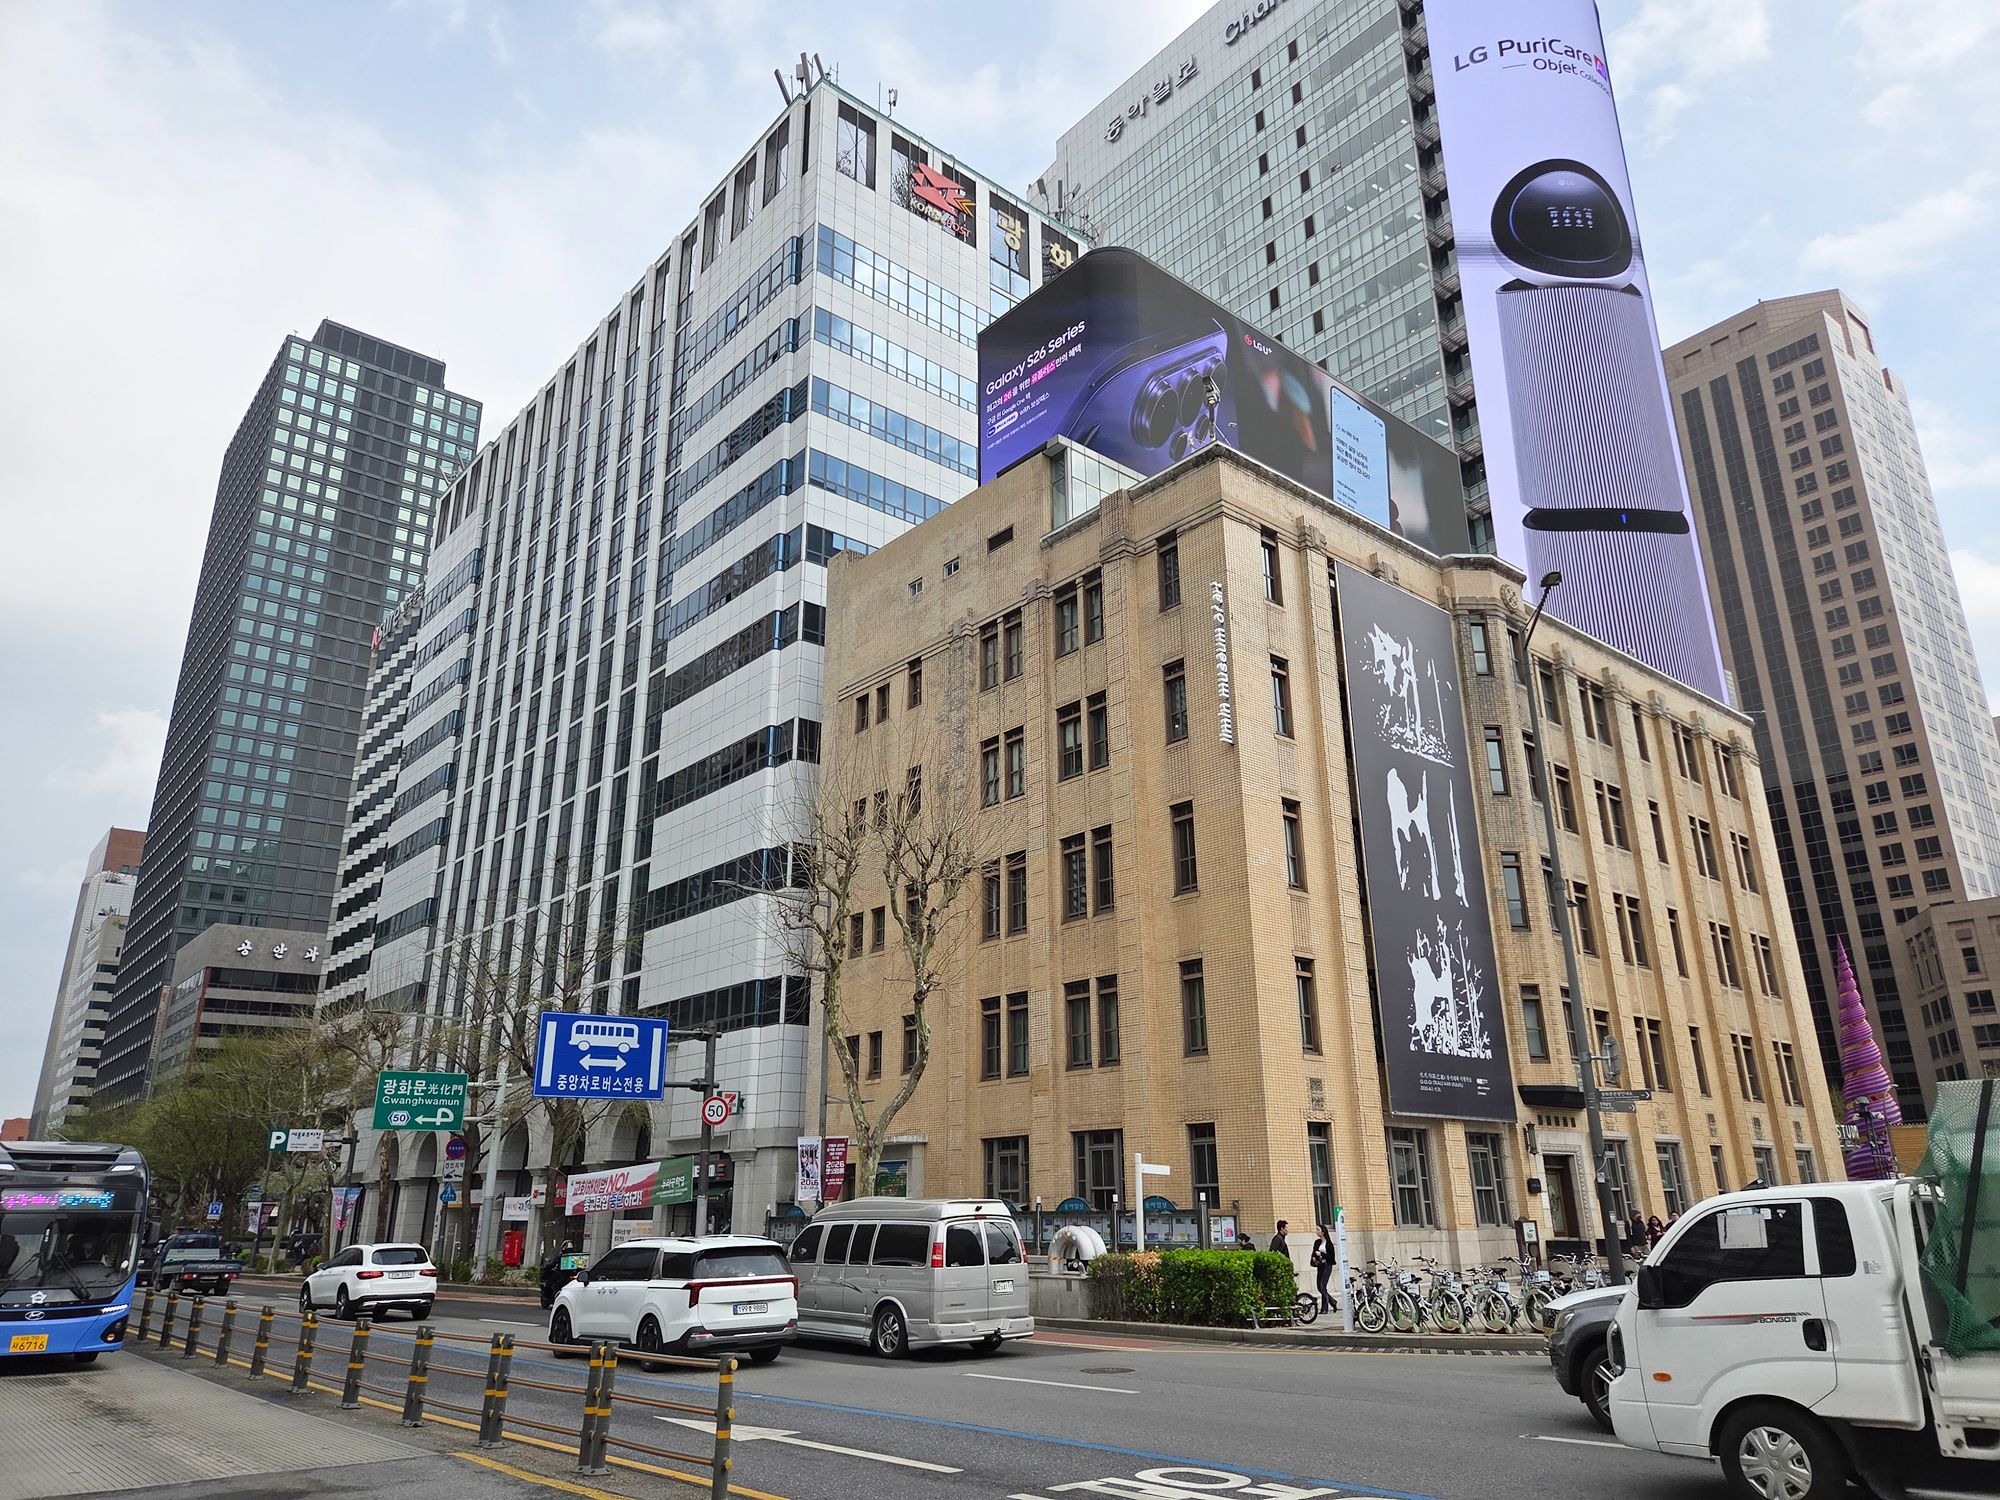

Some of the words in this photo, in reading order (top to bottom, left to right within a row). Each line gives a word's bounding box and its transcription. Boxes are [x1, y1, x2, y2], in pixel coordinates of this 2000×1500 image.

[1453, 46, 1488, 72] LG
[1498, 37, 1593, 67] PuriCare
[1533, 58, 1579, 76] Objet
[1104, 54, 1200, 143] 동아일보
[1253, 339, 1262, 352] LG
[986, 360, 1026, 395] Galaxy
[1026, 346, 1047, 368] S26
[1048, 320, 1086, 353] Series
[1211, 605, 1225, 624] of
[1214, 627, 1231, 699] museum
[236, 939, 320, 962] 공안과
[383, 1079, 427, 1096] 광화문
[427, 1083, 464, 1096] 光化門
[382, 1095, 460, 1107] Gwanghwamun
[392, 1113, 406, 1122] 50
[707, 1105, 724, 1118] 50
[269, 1131, 286, 1149] P
[826, 1161, 845, 1169] 2026
[606, 1172, 630, 1193] NO!
[800, 1178, 819, 1187] 2026
[583, 1194, 609, 1213] 종교탄압
[1760, 1316, 1791, 1324] BONGO
